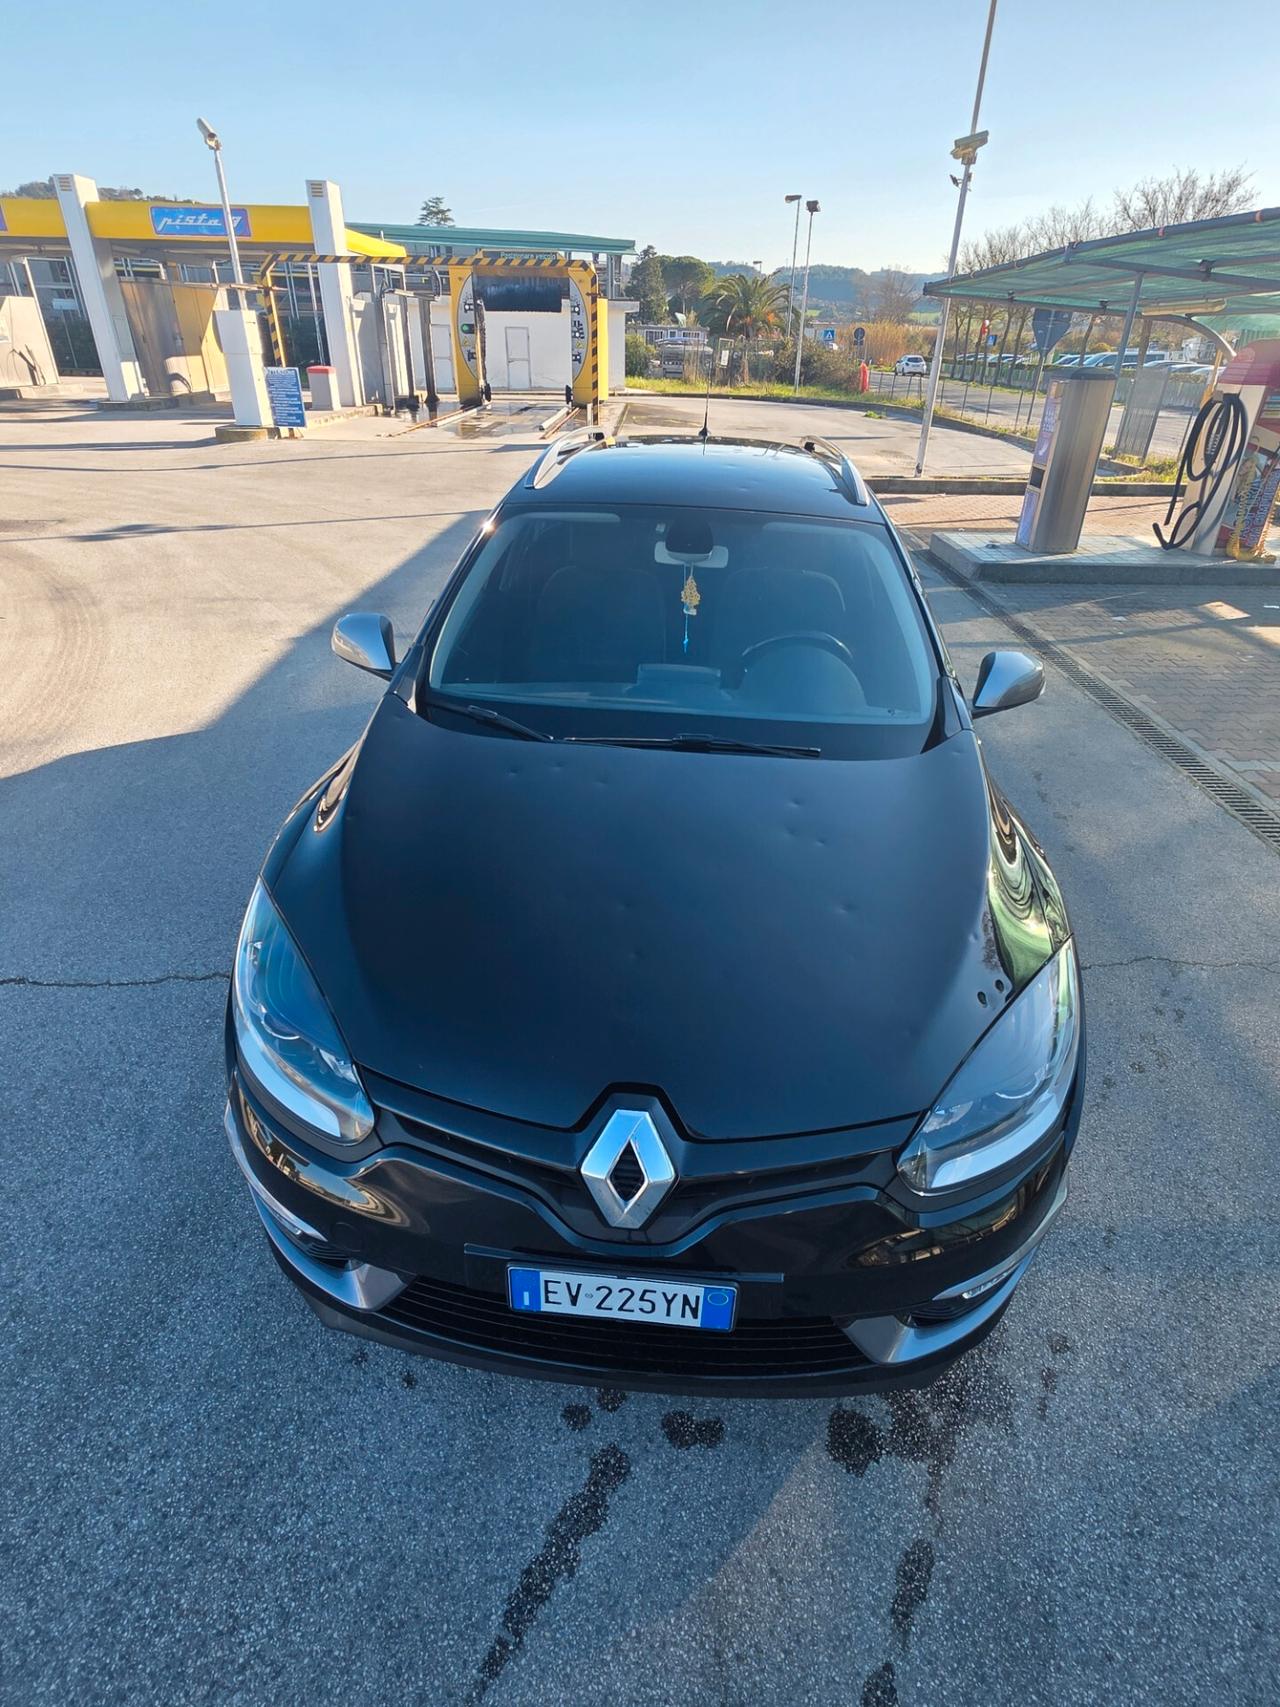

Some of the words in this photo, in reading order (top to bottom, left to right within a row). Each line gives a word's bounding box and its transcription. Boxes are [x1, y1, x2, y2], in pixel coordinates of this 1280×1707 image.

[157, 213, 221, 231] pista
[543, 1279, 582, 1307] EV
[594, 1284, 701, 1320] 225YN
